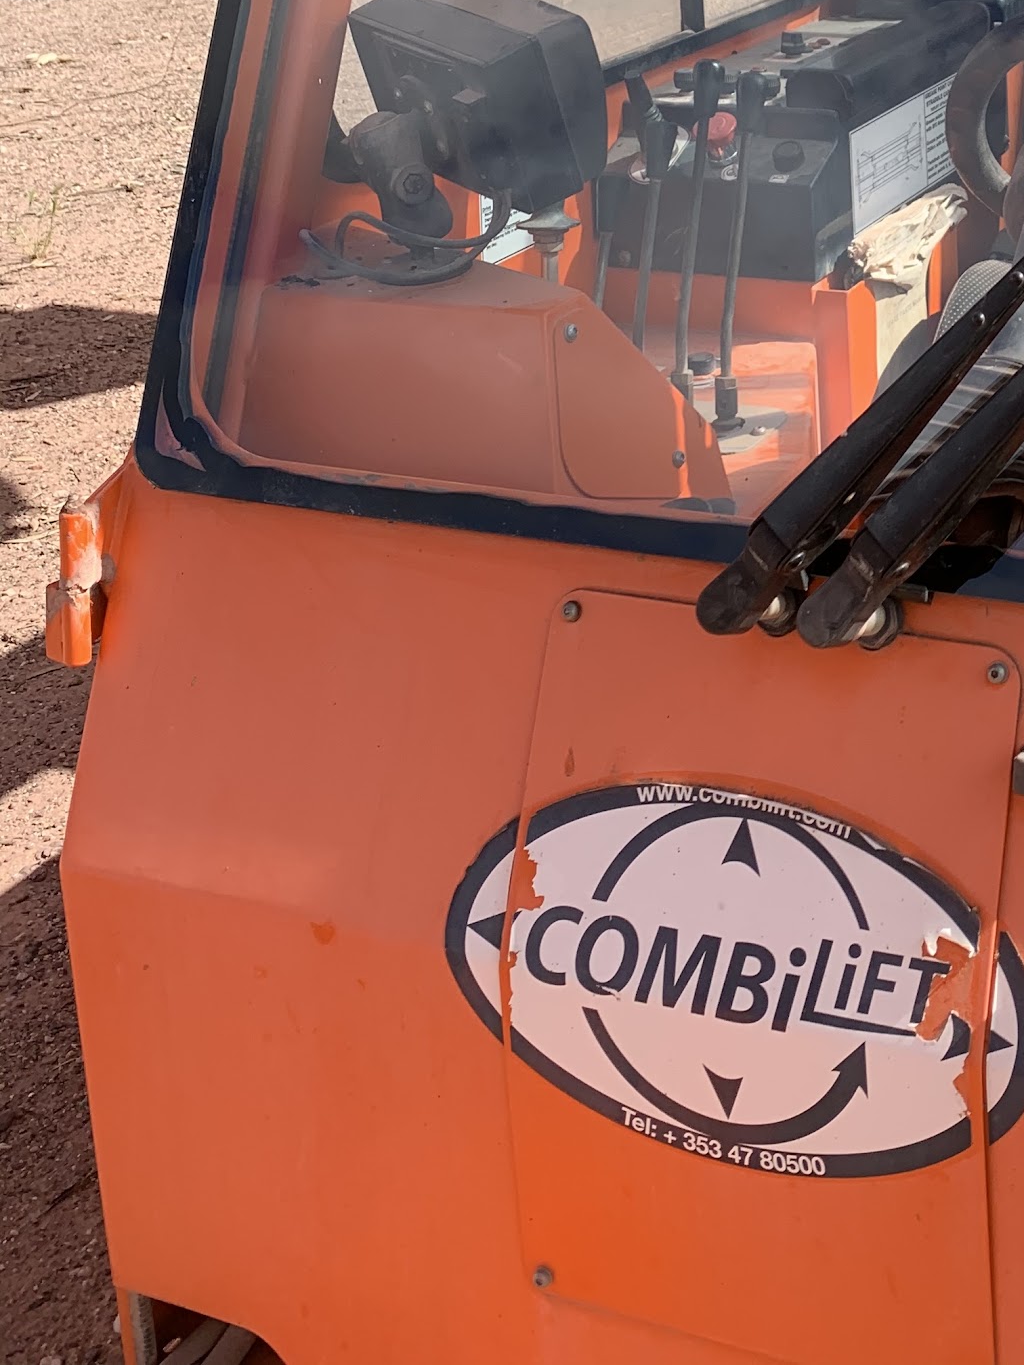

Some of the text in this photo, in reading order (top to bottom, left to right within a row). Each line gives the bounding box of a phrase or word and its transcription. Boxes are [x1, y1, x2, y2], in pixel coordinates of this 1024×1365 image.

[621, 1107, 826, 1176] Tel: + 353 47 80500
